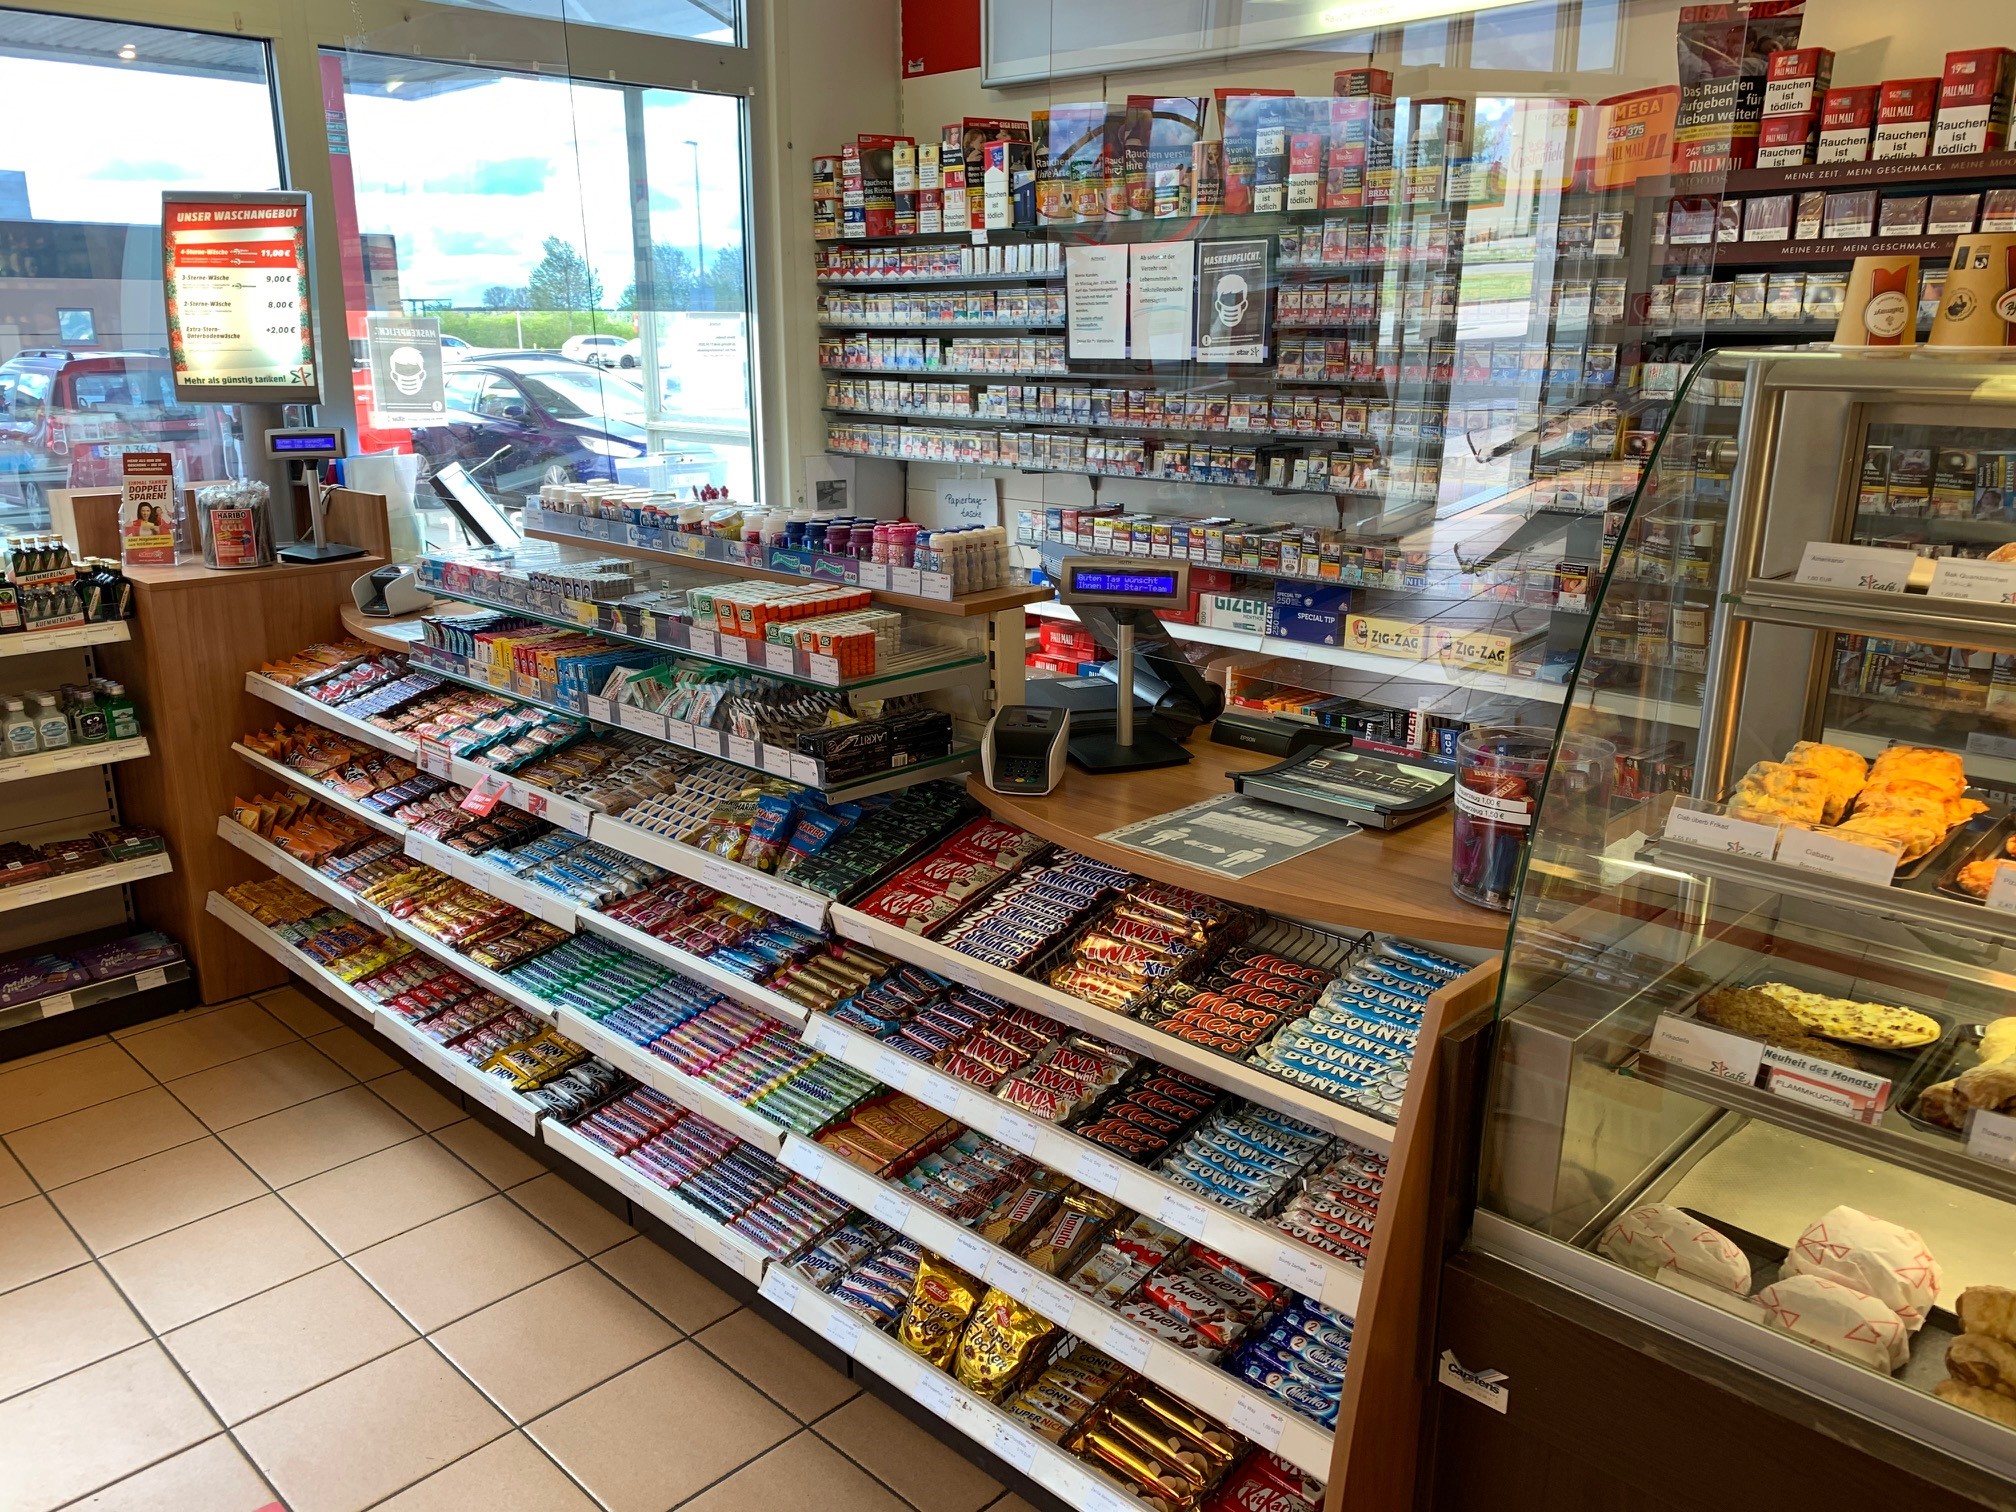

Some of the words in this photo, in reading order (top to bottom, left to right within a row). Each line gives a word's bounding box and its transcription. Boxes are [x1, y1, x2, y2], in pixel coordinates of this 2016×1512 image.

[1683, 86, 1701, 98] Das
[1614, 99, 1661, 119] MEGA
[1680, 94, 1733, 112] aufgeben
[1677, 111, 1714, 127] Lieben
[1626, 124, 1645, 136] 375
[1605, 144, 1623, 163] PALL
[1624, 141, 1645, 159] MALL
[1126, 161, 1144, 170] Ihre
[1784, 171, 1814, 181] MEINE
[1818, 169, 1842, 179] ZEIT.
[1846, 167, 1873, 177] MEIN
[1876, 163, 1946, 175] GESCHMACK.
[1951, 160, 1985, 170] MEINE
[1679, 174, 1729, 188] MOODS
[985, 190, 1007, 198] Rauchen
[177, 211, 211, 222] UNSER
[214, 208, 298, 221] WASCHANGEBOT
[261, 249, 283, 257] 11,00
[1781, 245, 1812, 255] MEINE
[1842, 243, 1868, 253] MEIN
[1872, 241, 1940, 251] GESCHMACK.
[1203, 251, 1262, 266] MASKENPFLICHT.
[266, 275, 285, 283] 9,00
[268, 301, 287, 309] 8,00
[266, 326, 289, 334] +2,00
[184, 377, 205, 385] Mehr
[208, 376, 220, 384] als
[222, 375, 253, 386] günstig
[255, 375, 286, 384] tanken!
[2006, 461, 2015, 493] DRUM
[128, 484, 168, 493] DOPPELT
[128, 492, 167, 501] SPAREN!
[217, 511, 247, 519] HARIBO
[25, 570, 67, 582] KUEMMERLING
[1077, 574, 1101, 582] Guten
[1106, 575, 1121, 584] Tag
[1124, 575, 1158, 585] wünscht
[1406, 577, 1424, 587] NIL
[1077, 581, 1102, 589] Ihnen
[1106, 582, 1120, 590] Ihr
[1124, 583, 1168, 593] Star-Team
[1872, 581, 1897, 592] café
[1214, 596, 1265, 616] GIZEH
[1276, 596, 1291, 605] 250
[35, 614, 76, 628] KUEMMERLING
[1243, 614, 1264, 622] MENTHOL
[1266, 606, 1274, 635] GIZEH
[1297, 612, 1323, 622] SPECIAL
[1324, 616, 1336, 624] TIP
[1371, 630, 1419, 649] ZIG-ZAG
[1456, 641, 1506, 662] ZIG-ZAG
[1239, 734, 1256, 743] EPSON
[1407, 711, 1418, 748] GIZEH
[852, 732, 889, 747] LAKRITZ
[1444, 733, 1453, 754] OCB
[1473, 769, 1507, 780] BREAK
[1495, 780, 1518, 798] BREAK
[757, 808, 782, 822] HARIBO
[801, 821, 825, 839] HARIBO
[970, 830, 1024, 847] KitKat
[1805, 848, 1835, 863] Ciabatta
[922, 860, 977, 881] KitKat
[1068, 863, 1139, 888] SNICKERS
[1037, 870, 1106, 896] SNICKERS
[880, 893, 935, 915] KitKat
[1026, 884, 1092, 908] SNICKERS
[1112, 917, 1176, 944] TWIX
[756, 938, 781, 948] OREO
[965, 929, 1033, 956] SNICKERS
[100, 951, 133, 967] Milka
[1086, 944, 1154, 965] TWIX
[2, 974, 38, 994] Milka
[1186, 992, 1278, 1028] Mars
[1172, 1007, 1262, 1040] Mars
[1330, 1013, 1418, 1050] BOUNTY
[661, 1036, 691, 1058] mentos
[1311, 1022, 1405, 1061] BOUNTY
[652, 1044, 681, 1064] mentos
[1051, 1047, 1105, 1077] TWIX
[1295, 1036, 1391, 1076] BOUNTY
[1075, 1071, 1102, 1085] white
[1723, 1069, 1747, 1083] café
[1764, 1048, 1808, 1072] Neuheit
[1809, 1060, 1829, 1075] des
[1830, 1067, 1878, 1092] Monats!
[1265, 1063, 1358, 1099] BOUNTY
[1006, 1077, 1057, 1111] TWIX
[1774, 1079, 1851, 1108] FLAMMKUCHEN
[758, 1105, 792, 1129] mentos
[1029, 1106, 1056, 1120] white
[1012, 1190, 1041, 1222] hanuta
[1053, 1212, 1081, 1247] hanuta
[848, 1273, 888, 1293] Knoppers
[1202, 1268, 1248, 1299] bueno
[831, 1285, 872, 1309] Knoppers
[1169, 1278, 1219, 1308] bueno
[1139, 1305, 1190, 1335] bueno
[1078, 1352, 1112, 1369] GÖNN
[1052, 1363, 1084, 1381] SUPER
[1448, 1363, 1500, 1395] Carstens
[1037, 1384, 1069, 1403] GÖNN
[1286, 1386, 1328, 1410] MilkyWay
[1009, 1404, 1041, 1423] SUPER
